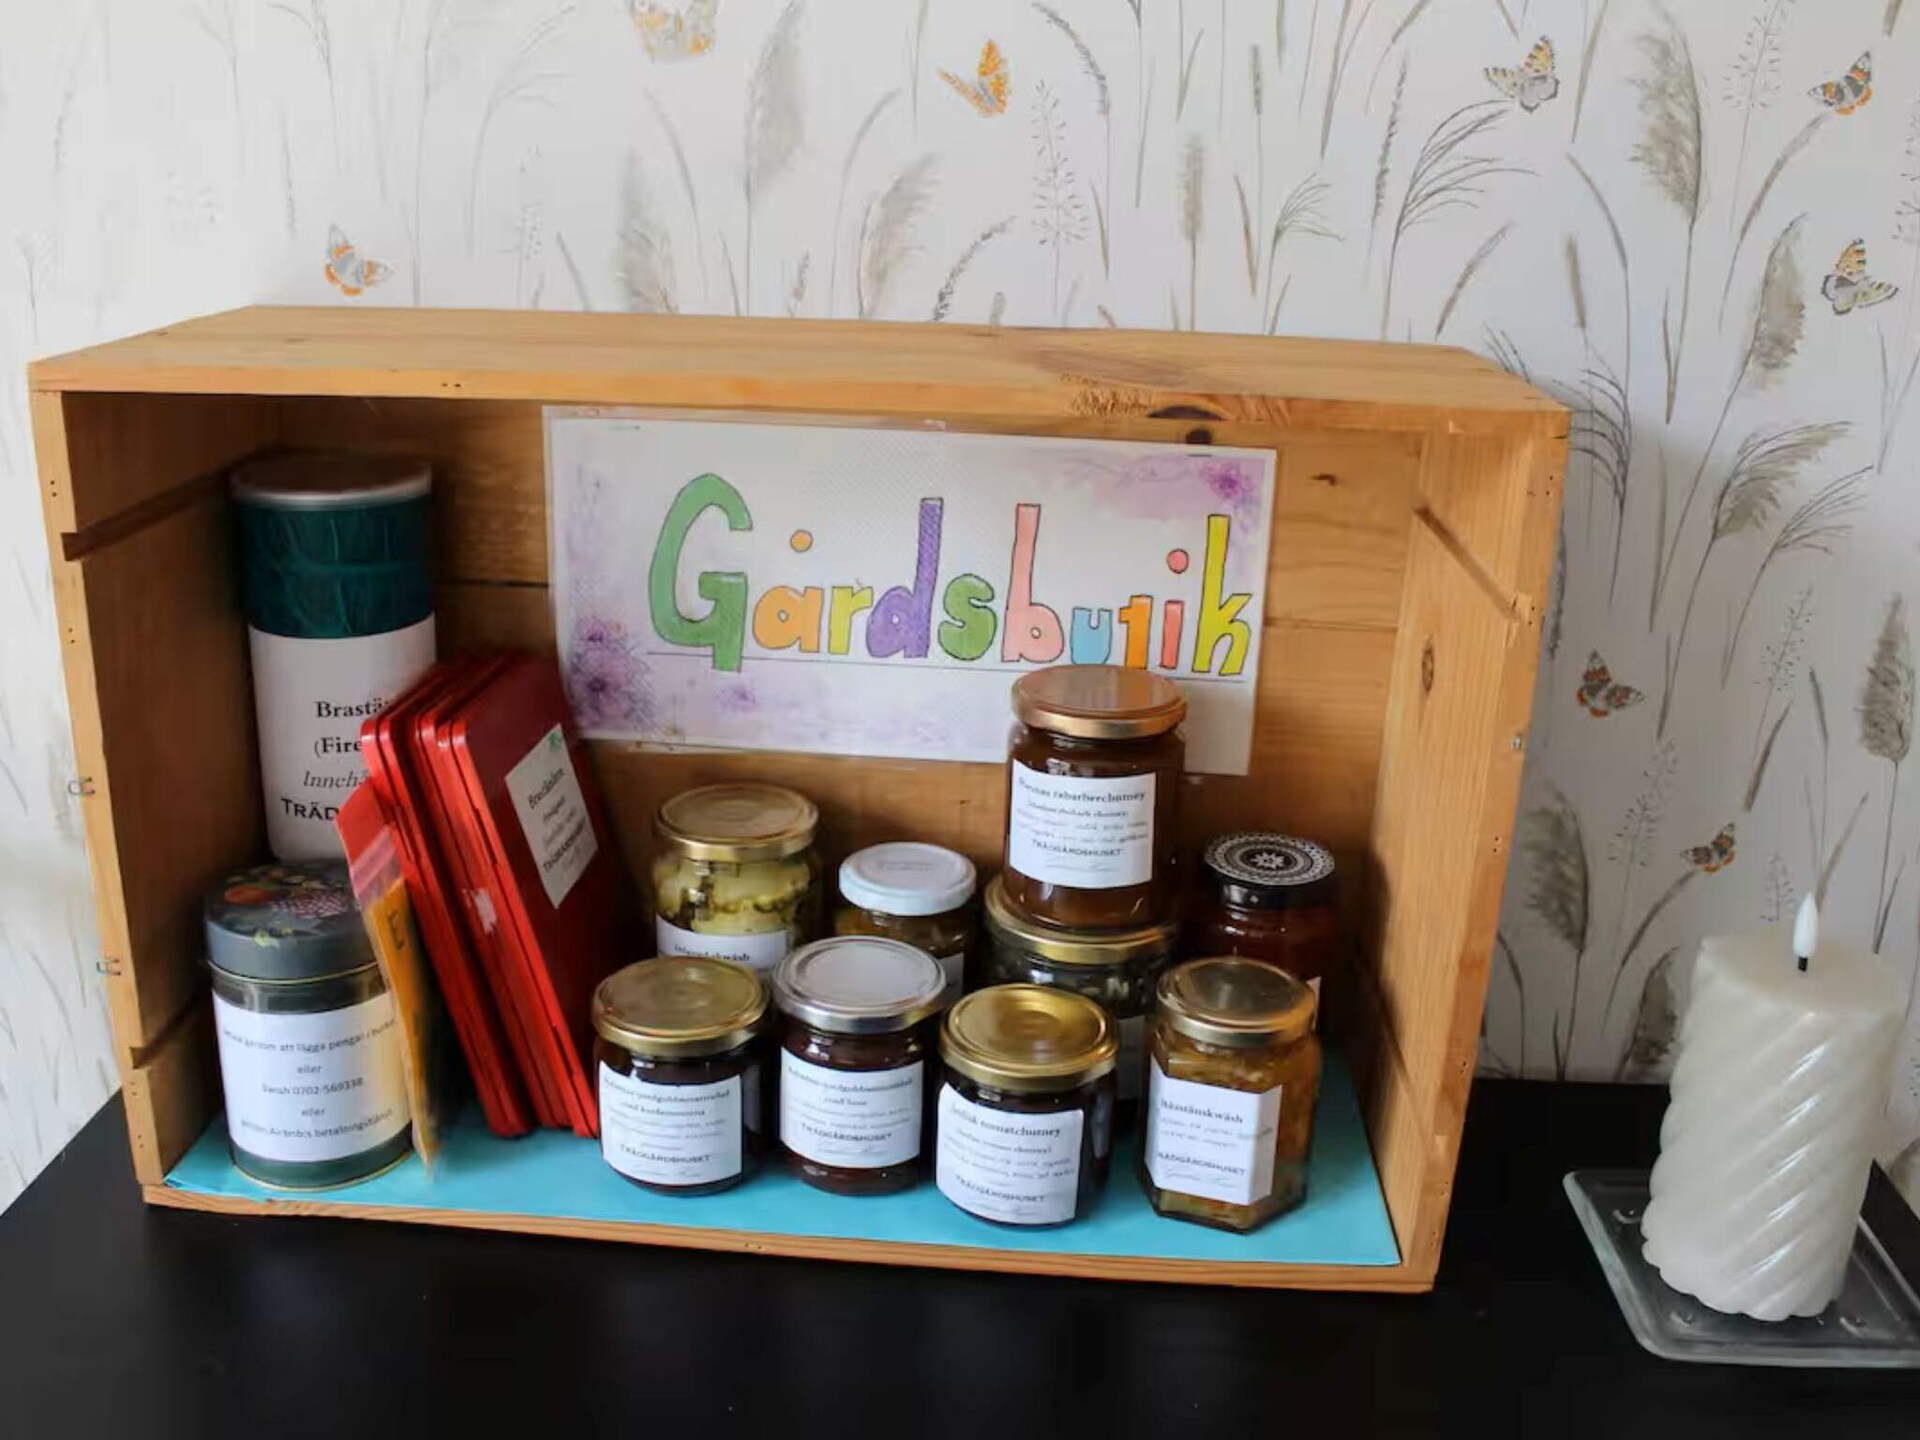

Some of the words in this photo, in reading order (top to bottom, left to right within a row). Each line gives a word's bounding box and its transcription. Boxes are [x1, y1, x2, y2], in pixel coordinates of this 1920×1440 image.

[648, 473, 1252, 675] Gårdsbutik
[316, 698, 389, 718] Brastä
[314, 736, 362, 758] (Fire
[281, 797, 339, 821] TRÄD
[280, 1042, 294, 1051] att
[296, 1042, 326, 1053] lägga
[329, 1033, 362, 1051] pengar
[297, 1064, 323, 1074] eller
[301, 1107, 326, 1117] eller
